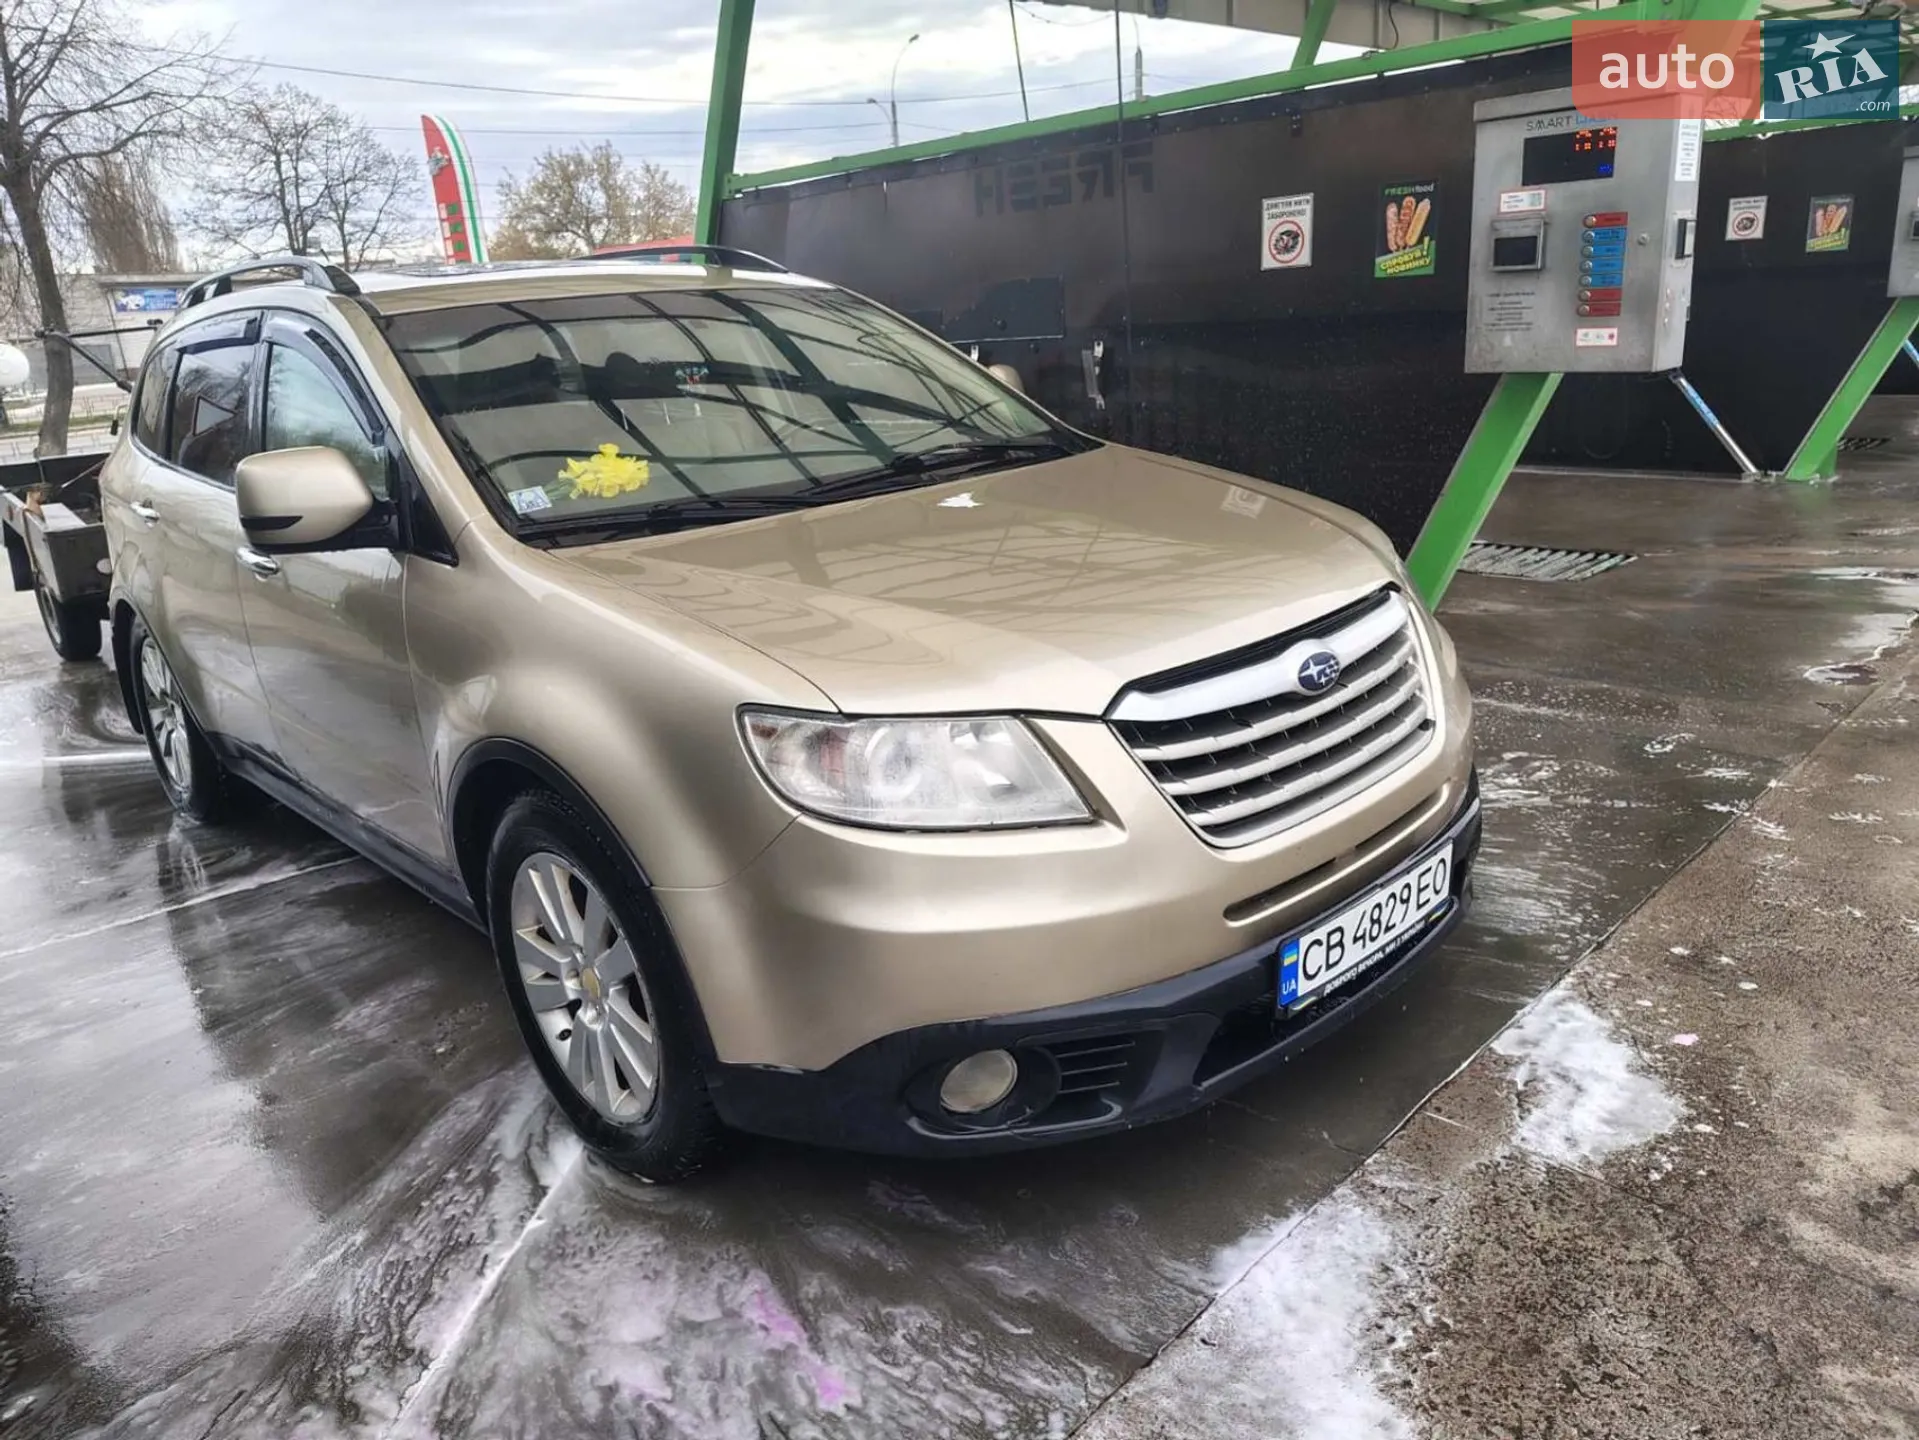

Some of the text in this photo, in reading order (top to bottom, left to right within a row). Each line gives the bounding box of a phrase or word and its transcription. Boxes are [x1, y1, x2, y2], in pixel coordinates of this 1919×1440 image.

[1526, 115, 1572, 131] SMART
[1302, 925, 1344, 981] CB
[1282, 979, 1297, 995] UA
